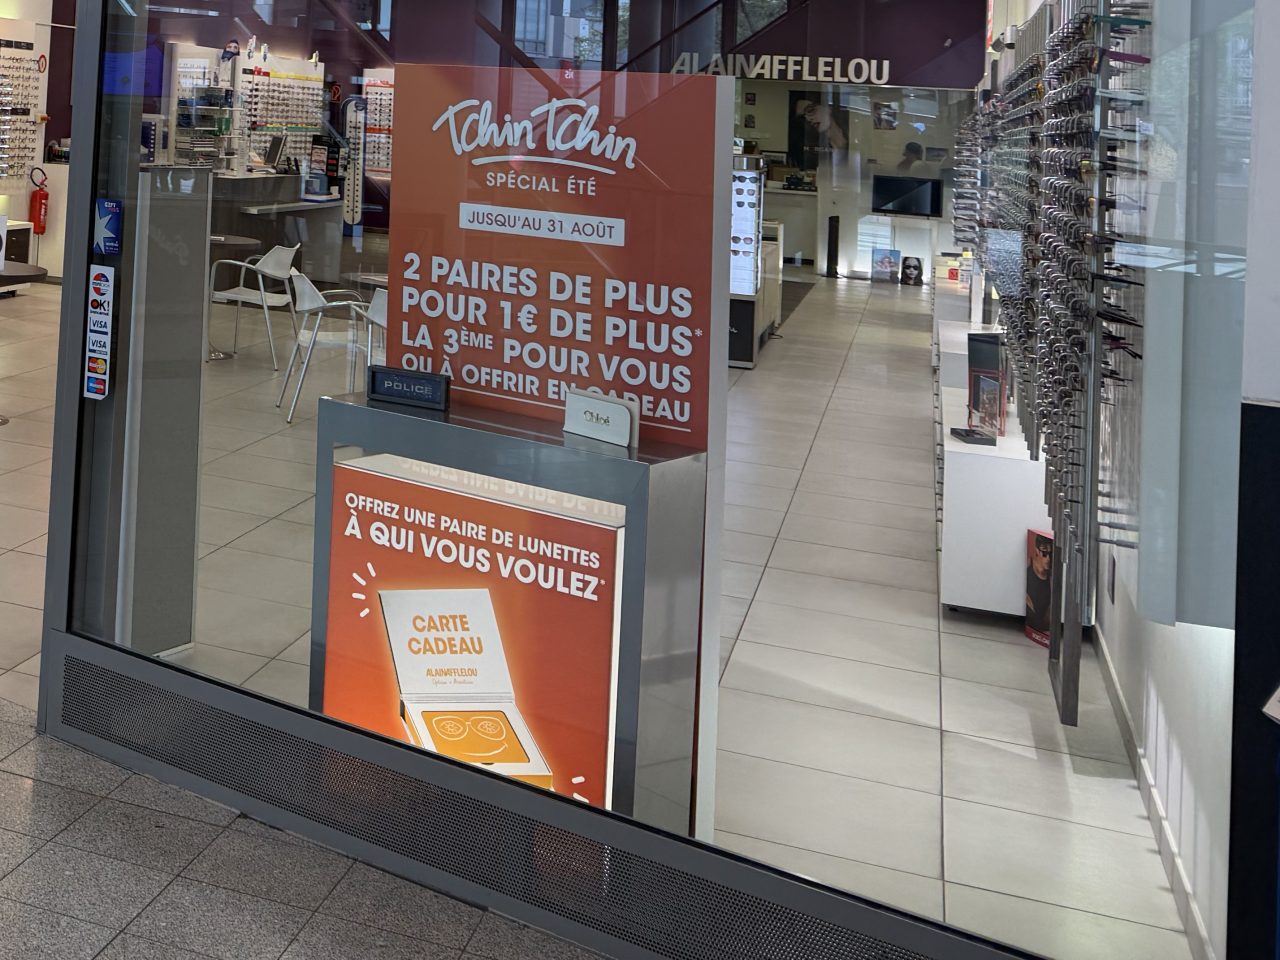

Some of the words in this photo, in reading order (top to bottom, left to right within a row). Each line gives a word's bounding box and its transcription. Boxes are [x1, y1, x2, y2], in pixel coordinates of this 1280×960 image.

[670, 51, 890, 85] ALAINAFFLELOU
[486, 170, 560, 193] SPÉCIAL
[567, 176, 597, 197] ÉTÉ
[468, 209, 542, 231] JUSQU'AU
[547, 219, 565, 234] 31
[571, 221, 615, 240] AOÛT
[403, 252, 421, 281] 2
[431, 255, 538, 298] PAIRES
[549, 271, 592, 306] DE
[604, 278, 693, 319] PLUS
[92, 319, 108, 330] VISA
[402, 285, 487, 327] POUR
[499, 300, 539, 334] 1€
[550, 308, 592, 342] DE
[91, 339, 107, 350] VISA
[401, 320, 433, 351] LA
[443, 325, 493, 355] 3ÈME
[504, 338, 590, 378] POUR
[598, 352, 692, 394] VOUS
[384, 381, 433, 395] POLICE
[401, 352, 432, 373] OU
[439, 354, 455, 381] À
[461, 363, 540, 397] OFFRIR
[547, 378, 577, 401] EN
[583, 410, 610, 426] Chloé
[344, 509, 362, 540] À
[369, 522, 415, 554] QUI
[419, 532, 491, 574] VOUS
[345, 492, 400, 520] OFFREZ
[404, 506, 436, 529] UNE
[440, 516, 487, 542] PAIRE
[491, 527, 513, 548] DE
[518, 534, 600, 570] LUNETTES
[412, 614, 471, 633] CARTE
[407, 636, 484, 656] CADEAU
[425, 668, 478, 677] ALAINAFFLELOU
